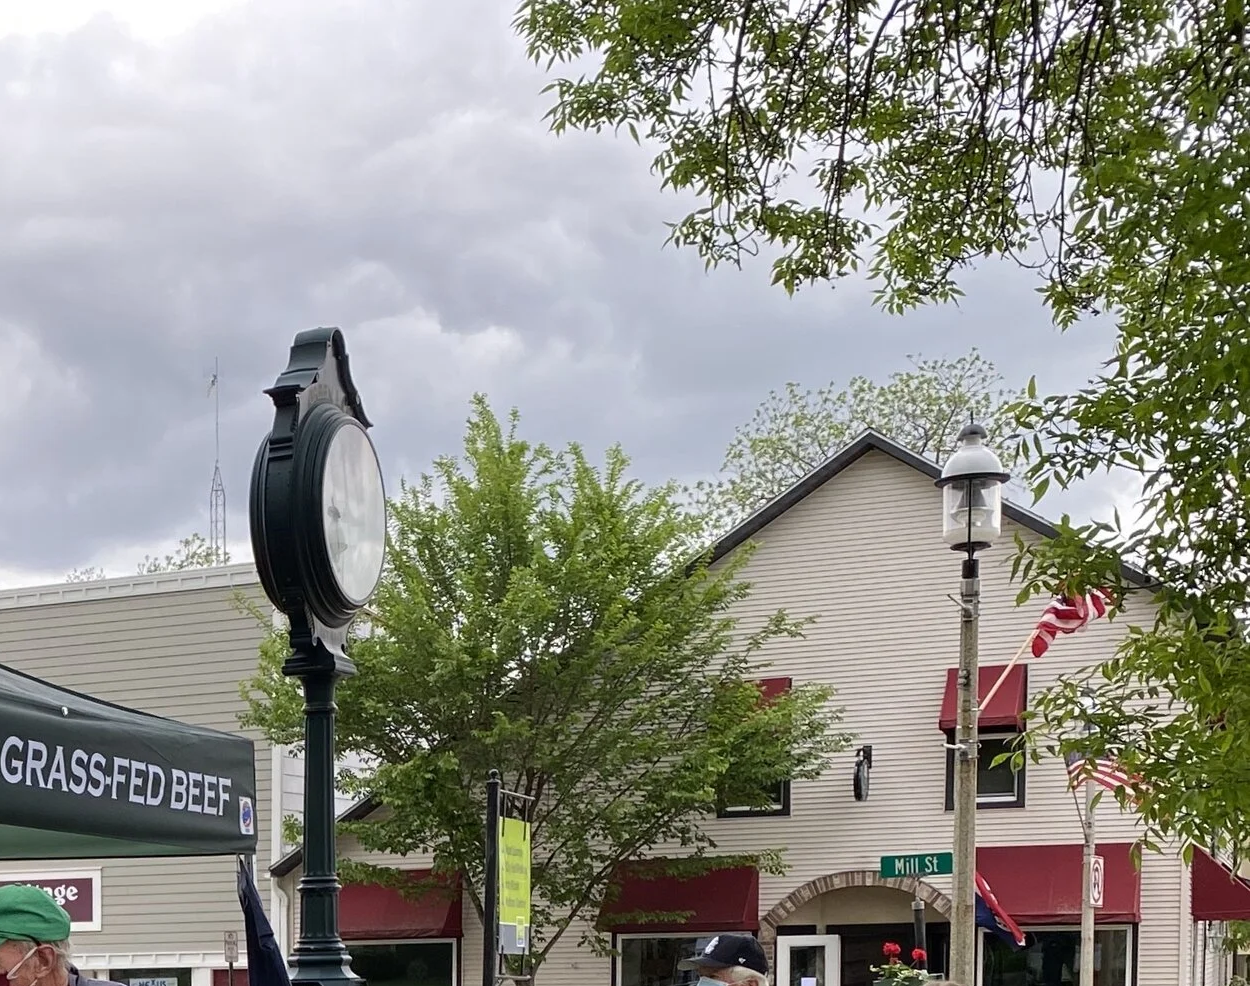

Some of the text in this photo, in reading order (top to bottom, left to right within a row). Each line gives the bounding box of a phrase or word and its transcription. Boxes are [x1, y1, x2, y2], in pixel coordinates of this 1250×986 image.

[0, 735, 232, 817] GRASS-FED BEEF
[895, 856, 939, 875] Mill St
